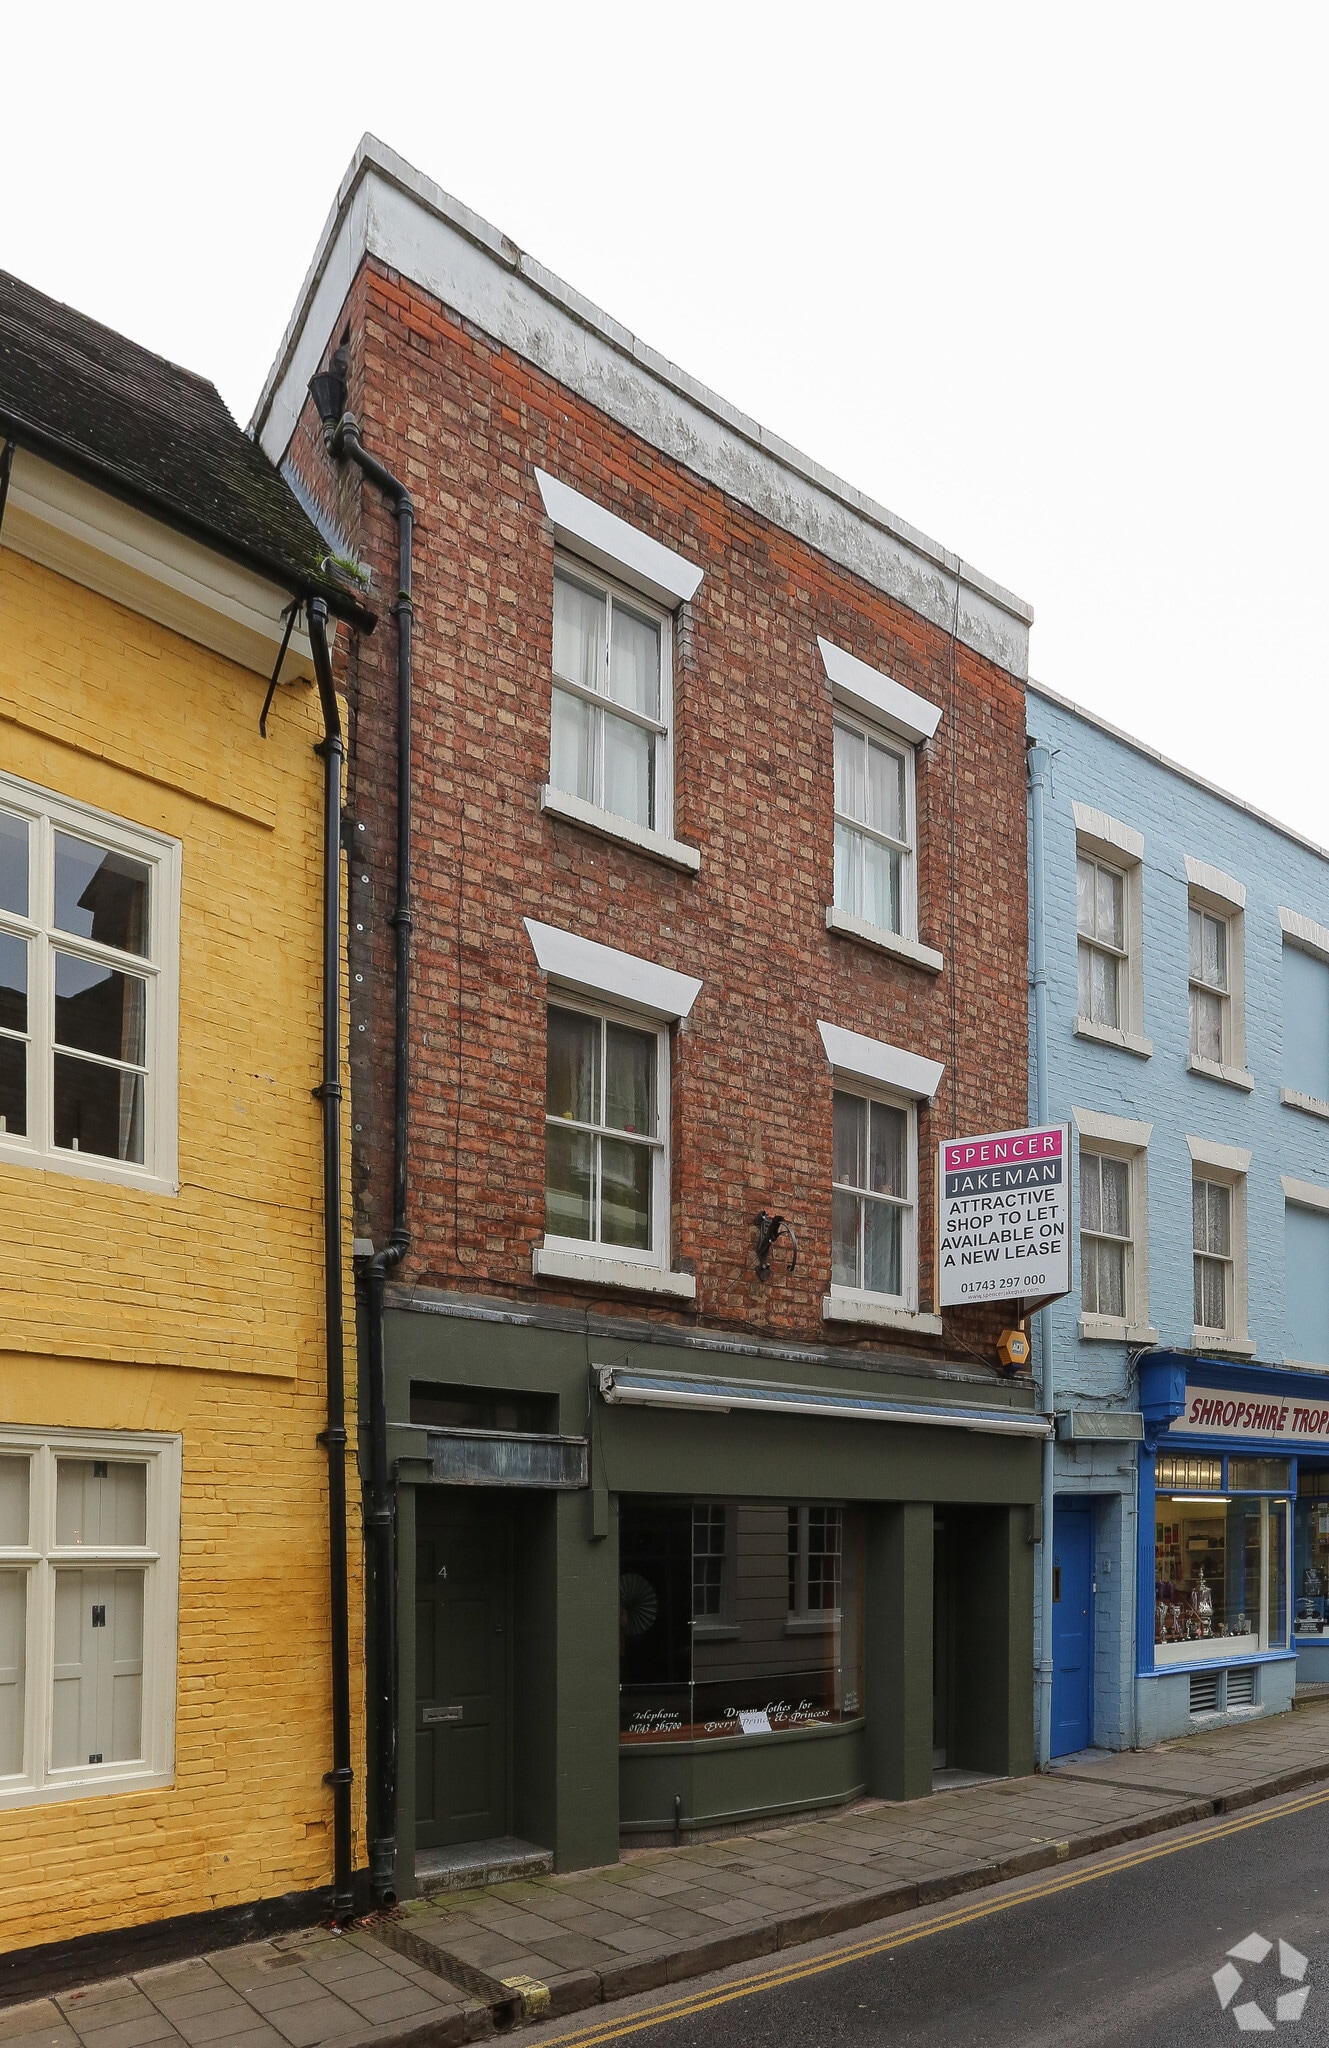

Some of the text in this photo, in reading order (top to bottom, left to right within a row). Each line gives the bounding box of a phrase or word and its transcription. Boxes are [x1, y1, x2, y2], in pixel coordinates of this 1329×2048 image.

[951, 1136, 1055, 1165] SPENCER
[951, 1164, 1056, 1193] JAKEMAN
[949, 1188, 1055, 1215] ATTRACTIVE
[946, 1205, 1059, 1233] SHOP TO LET
[941, 1222, 1065, 1251] AVAILABLE ON
[944, 1240, 1061, 1267] A NEW LEASE
[960, 1274, 1046, 1293] 01743 297 000
[1012, 1343, 1024, 1352] ADT
[1189, 1398, 1289, 1431] SHROPSHIRE
[438, 1565, 448, 1579] 4
[633, 1709, 679, 1722] Telephone
[795, 1699, 812, 1712] for
[629, 1724, 651, 1734] 01743
[704, 1720, 736, 1732] Every
[775, 1712, 787, 1722] &
[790, 1709, 830, 1721] Princess
